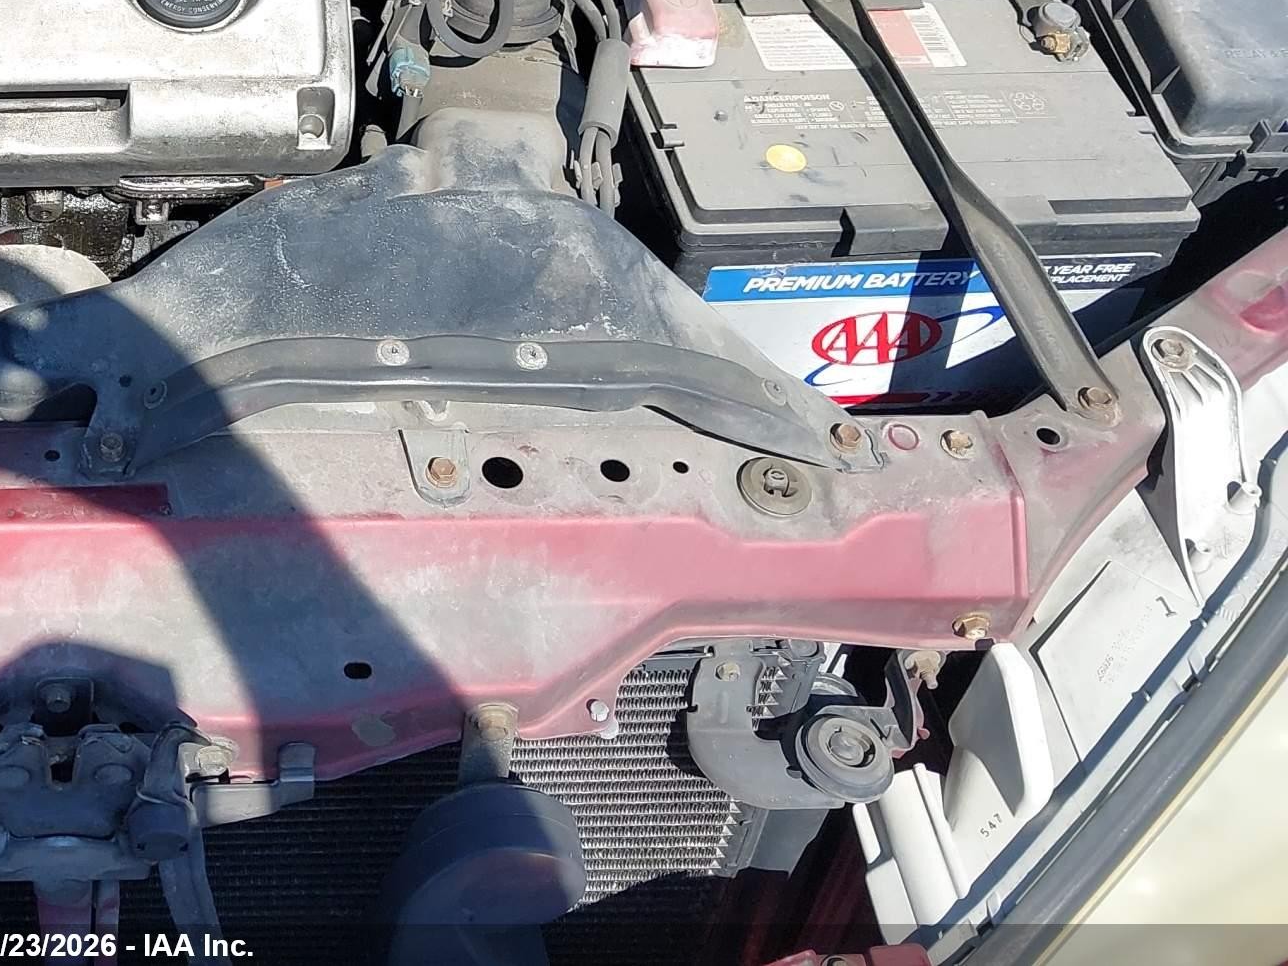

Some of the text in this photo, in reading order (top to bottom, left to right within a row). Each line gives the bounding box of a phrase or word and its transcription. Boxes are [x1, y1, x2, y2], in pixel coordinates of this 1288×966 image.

[1052, 262, 1137, 275] YEAR FREE
[742, 269, 981, 294] PREMIUM BATTERY
[1050, 273, 1130, 284] PLACEMENT
[822, 313, 928, 365] AAA
